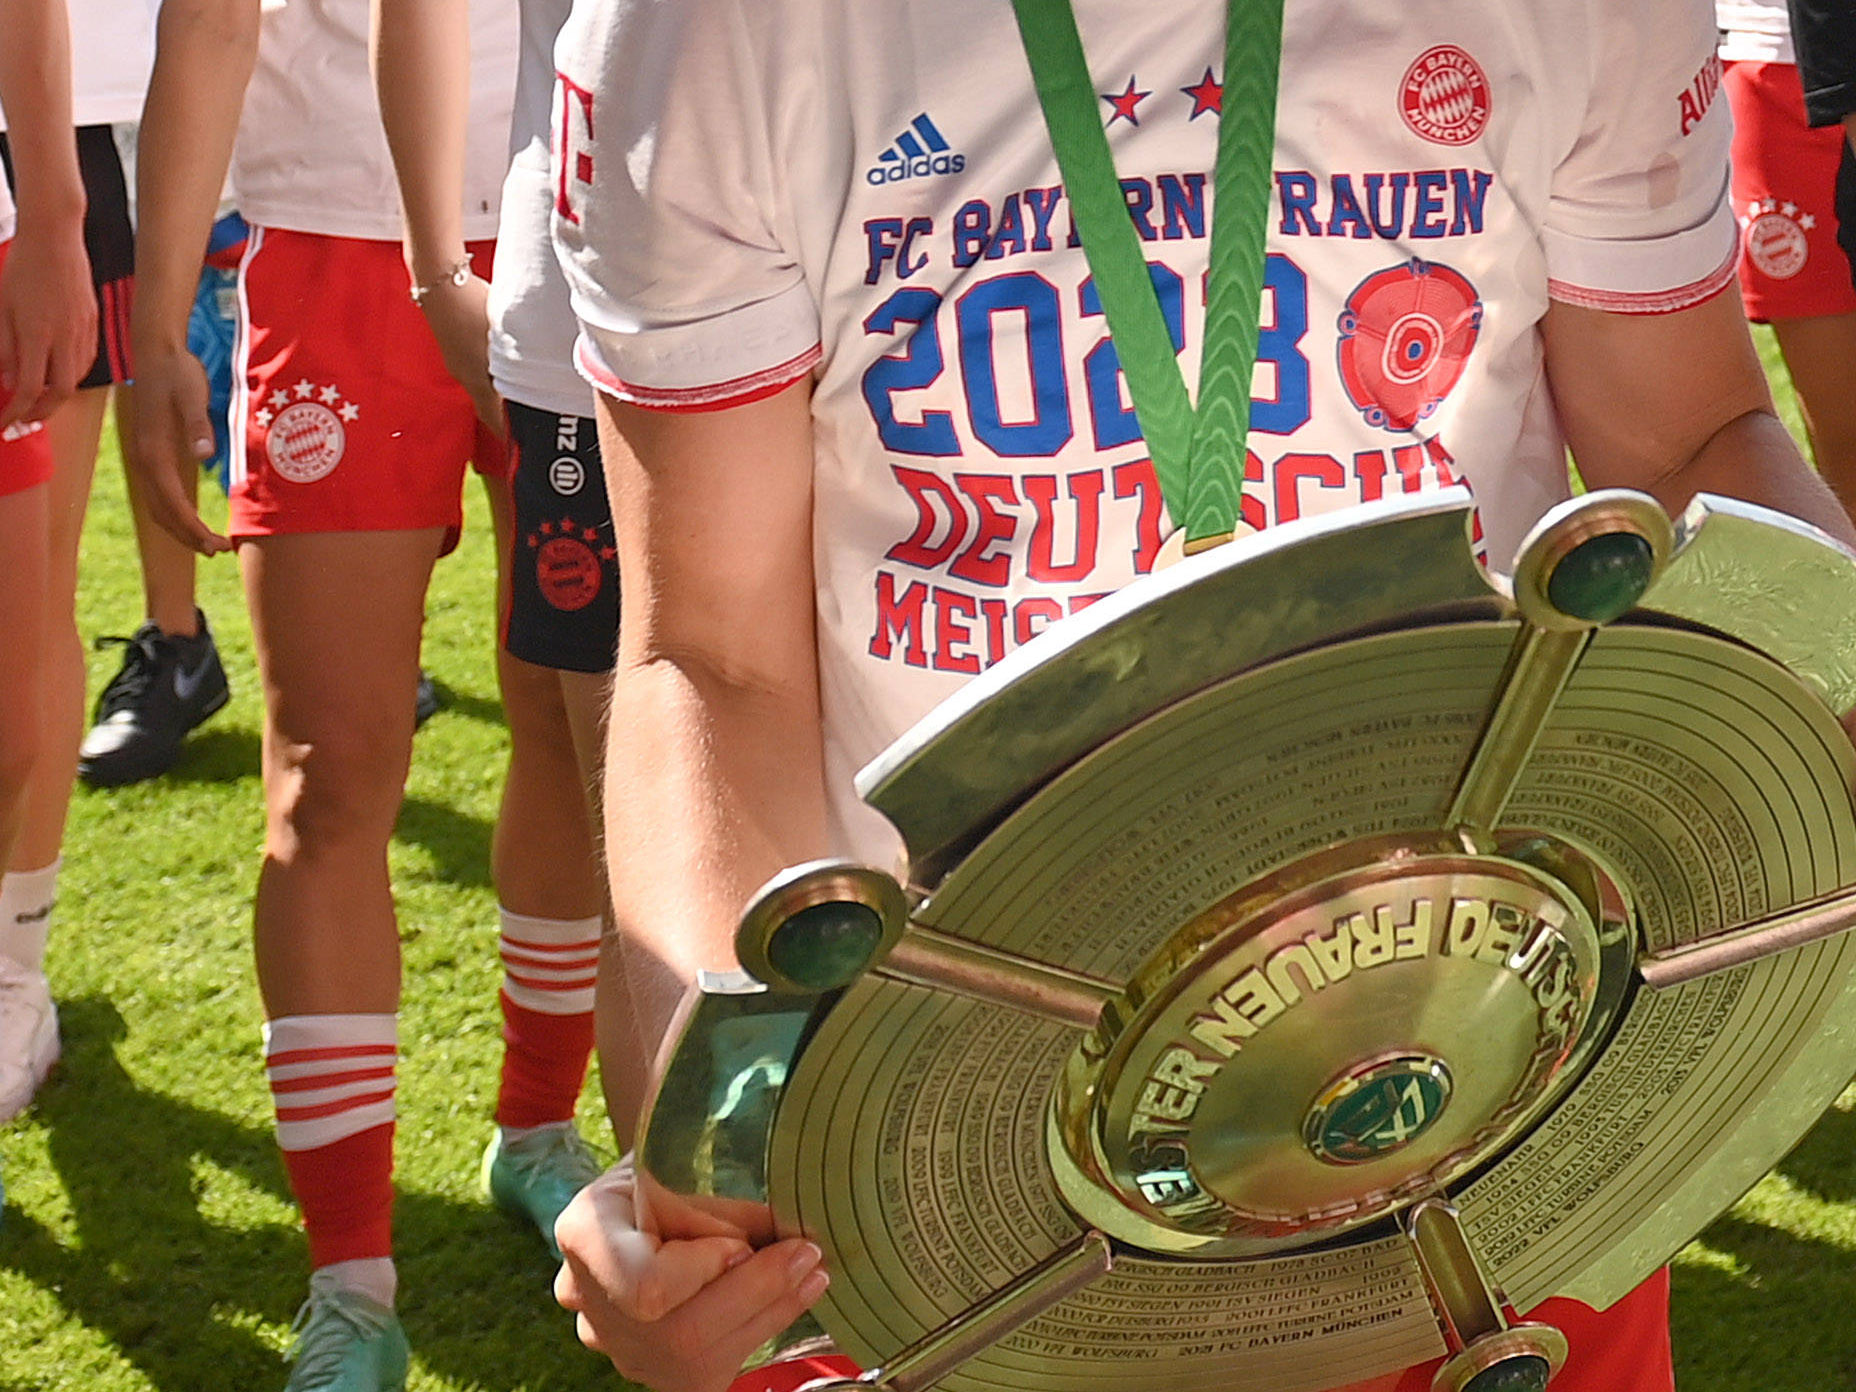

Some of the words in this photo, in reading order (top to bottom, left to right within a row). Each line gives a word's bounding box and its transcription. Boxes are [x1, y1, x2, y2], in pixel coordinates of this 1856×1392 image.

[1408, 67, 1428, 93] FC
[1426, 49, 1481, 89] BAYERN
[866, 151, 966, 187] adidas
[864, 216, 933, 285] FC
[1273, 168, 1493, 241] RAUEN
[1189, 896, 1434, 1060] FRAUEN
[1247, 1329, 1316, 1350] BAYERN
